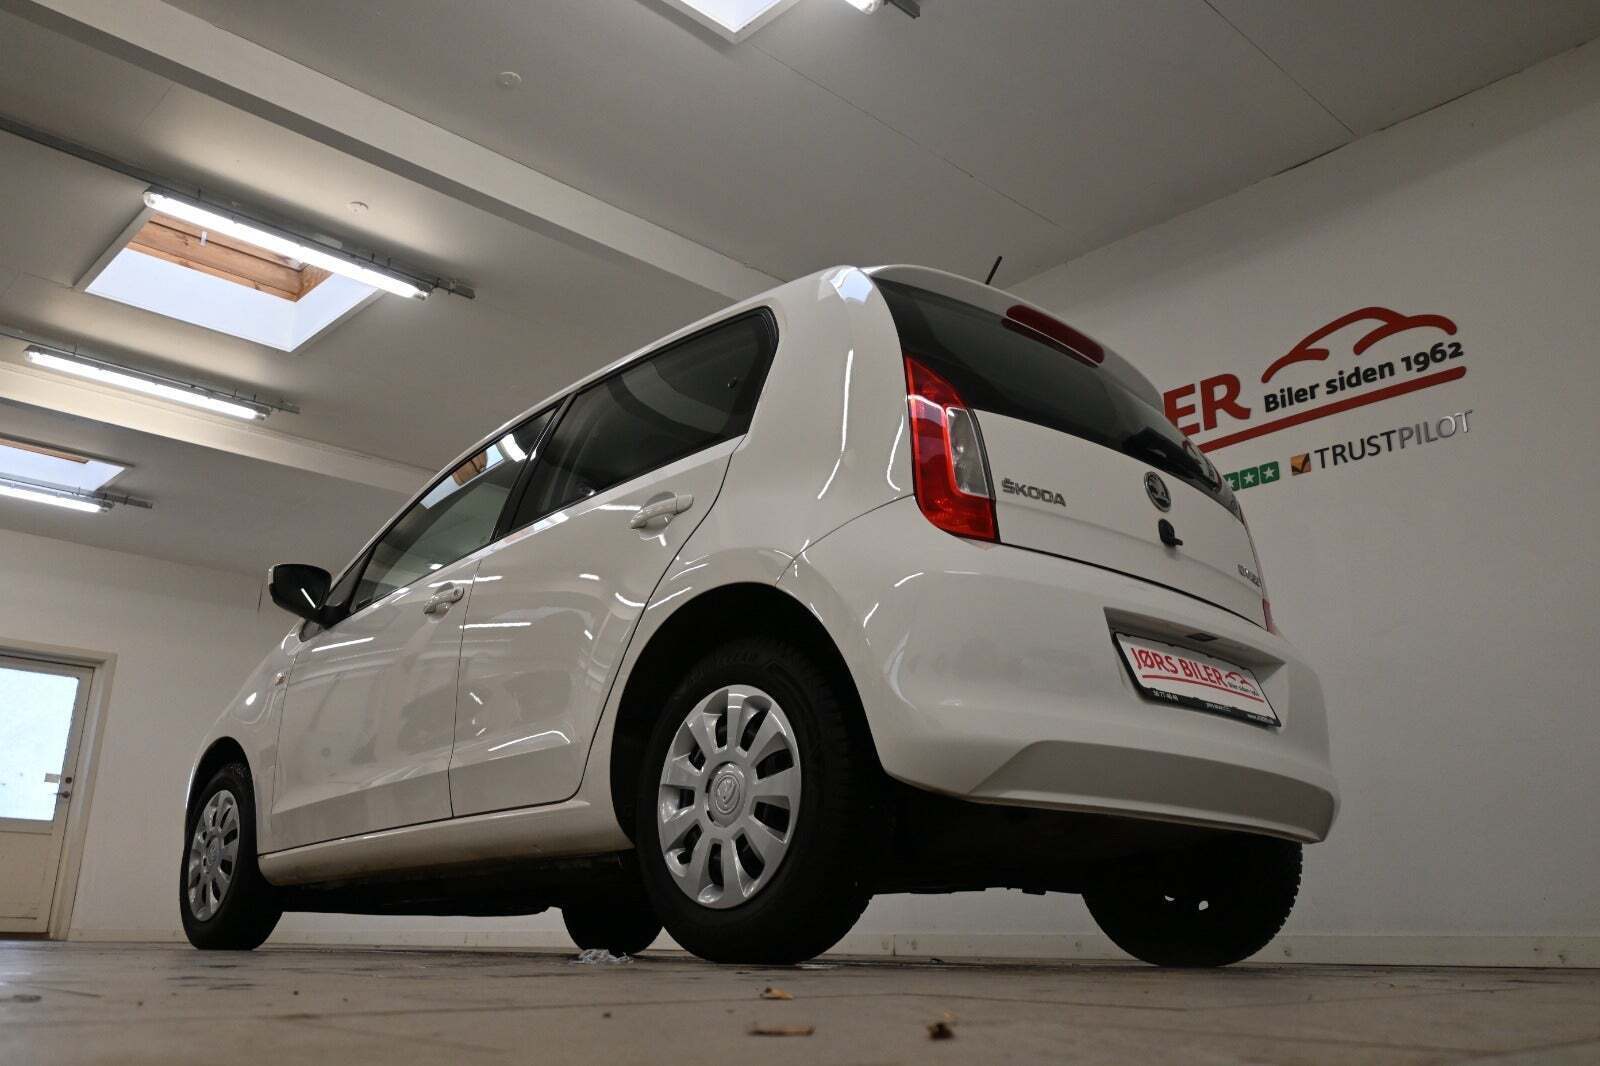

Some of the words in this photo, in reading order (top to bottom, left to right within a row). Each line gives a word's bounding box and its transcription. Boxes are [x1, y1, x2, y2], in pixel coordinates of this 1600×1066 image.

[1264, 382, 1320, 413] Biler
[1327, 362, 1395, 394] siden
[1401, 341, 1465, 373] 1962
[1314, 409, 1474, 469] TRUSTPILOT
[1179, 658, 1228, 688] BILER
